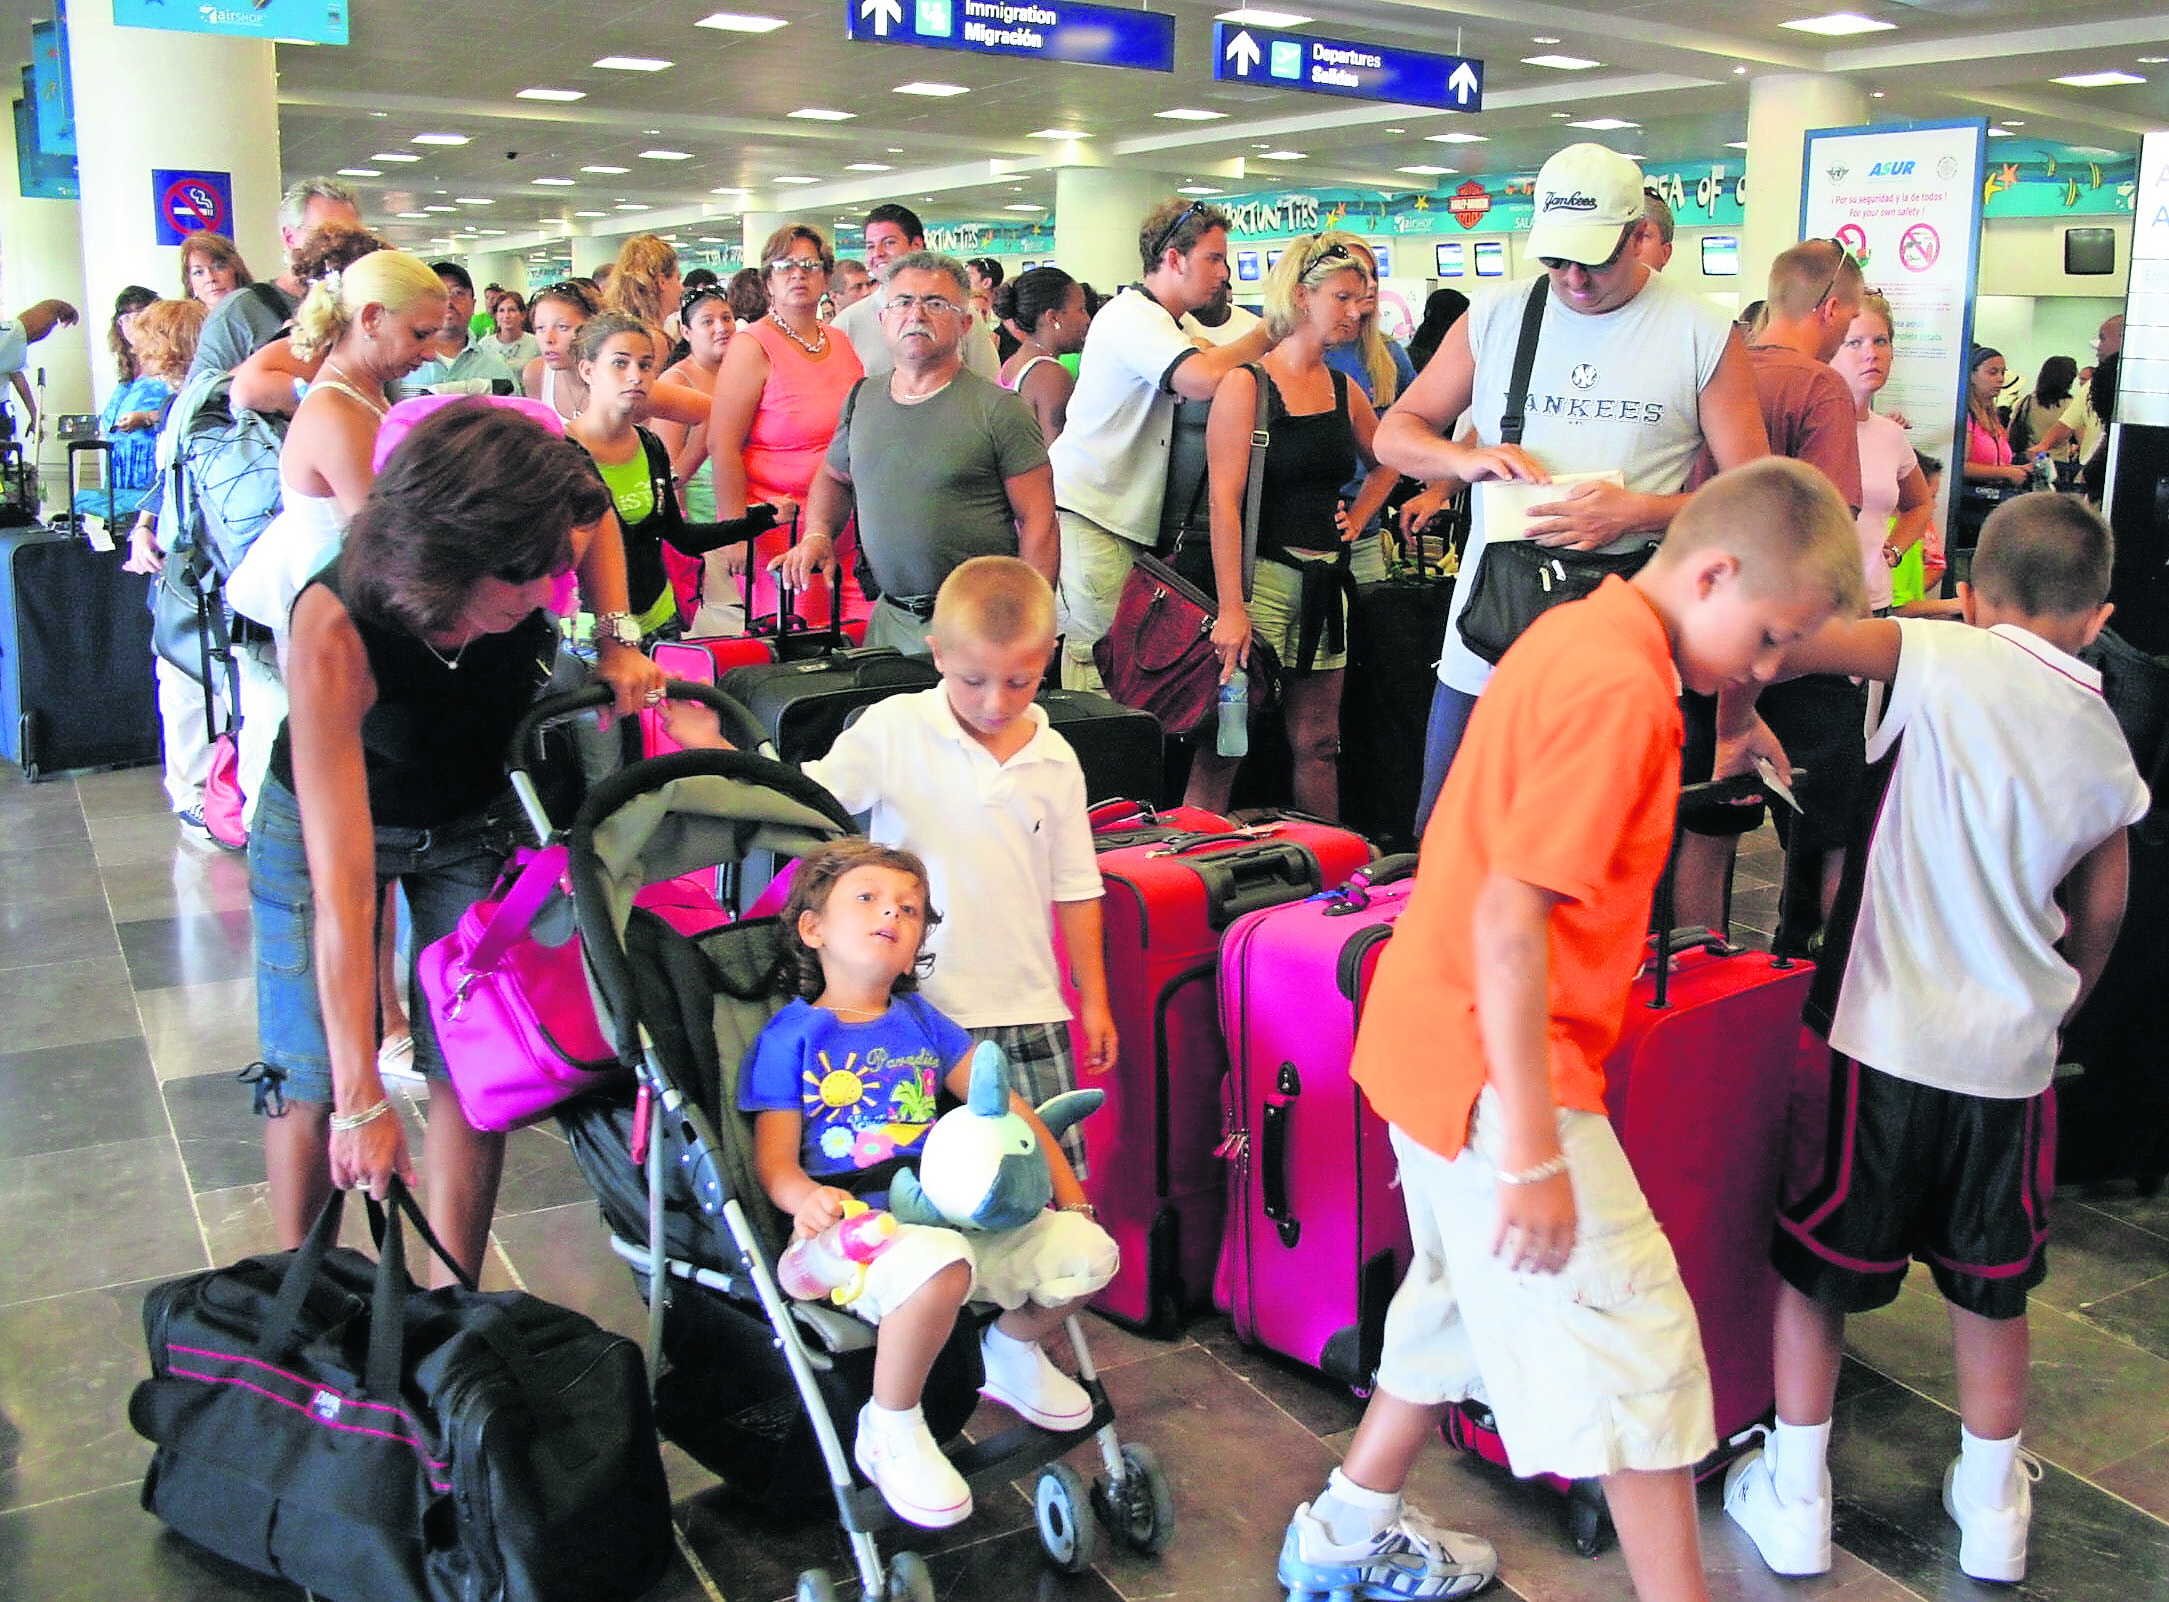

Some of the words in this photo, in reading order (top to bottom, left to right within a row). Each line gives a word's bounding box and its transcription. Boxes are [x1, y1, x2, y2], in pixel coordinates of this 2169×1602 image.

[965, 0, 1057, 25] Immigration
[964, 21, 1044, 48] Migración
[1312, 43, 1382, 69] Departures
[1868, 161, 1916, 177] ASUR
[1543, 191, 1598, 213] Yankees
[1503, 391, 1666, 424] ANKEES
